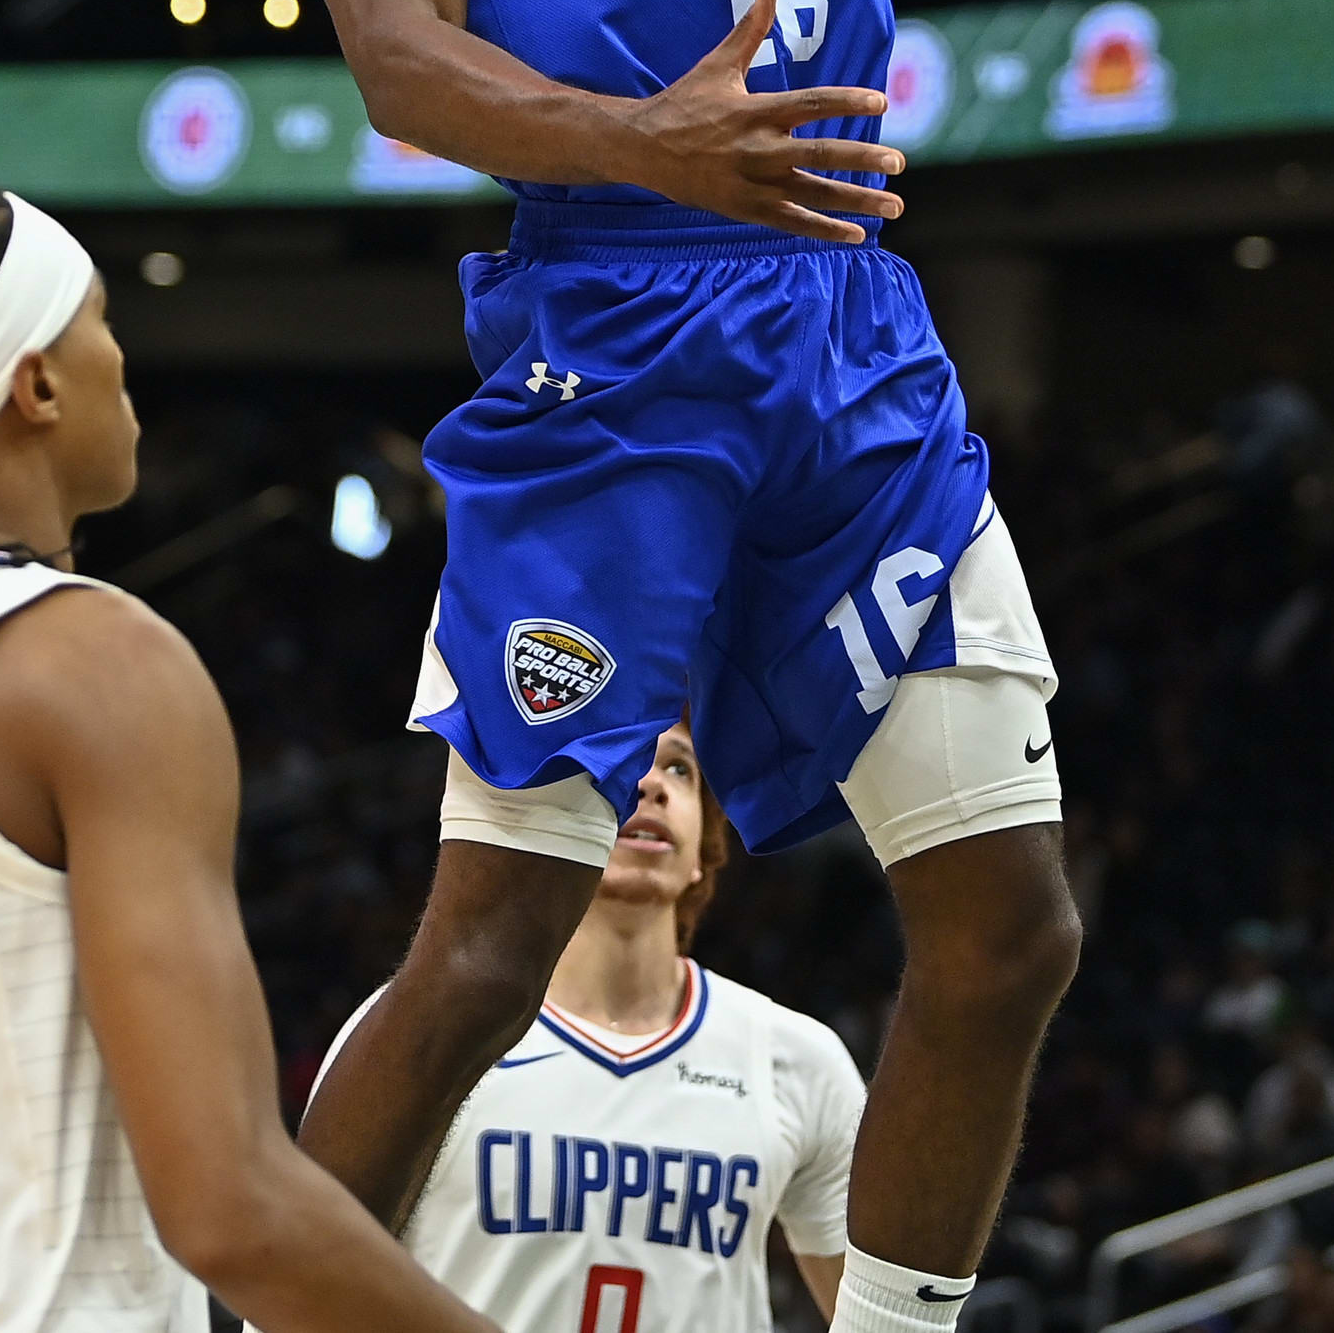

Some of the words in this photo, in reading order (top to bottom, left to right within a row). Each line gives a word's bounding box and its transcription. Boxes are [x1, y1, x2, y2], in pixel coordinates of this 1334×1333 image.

[514, 637, 557, 661] PRO
[543, 633, 584, 655] MACCABI
[513, 654, 595, 694] SPORTS
[475, 1128, 759, 1258] CLIPPERS
